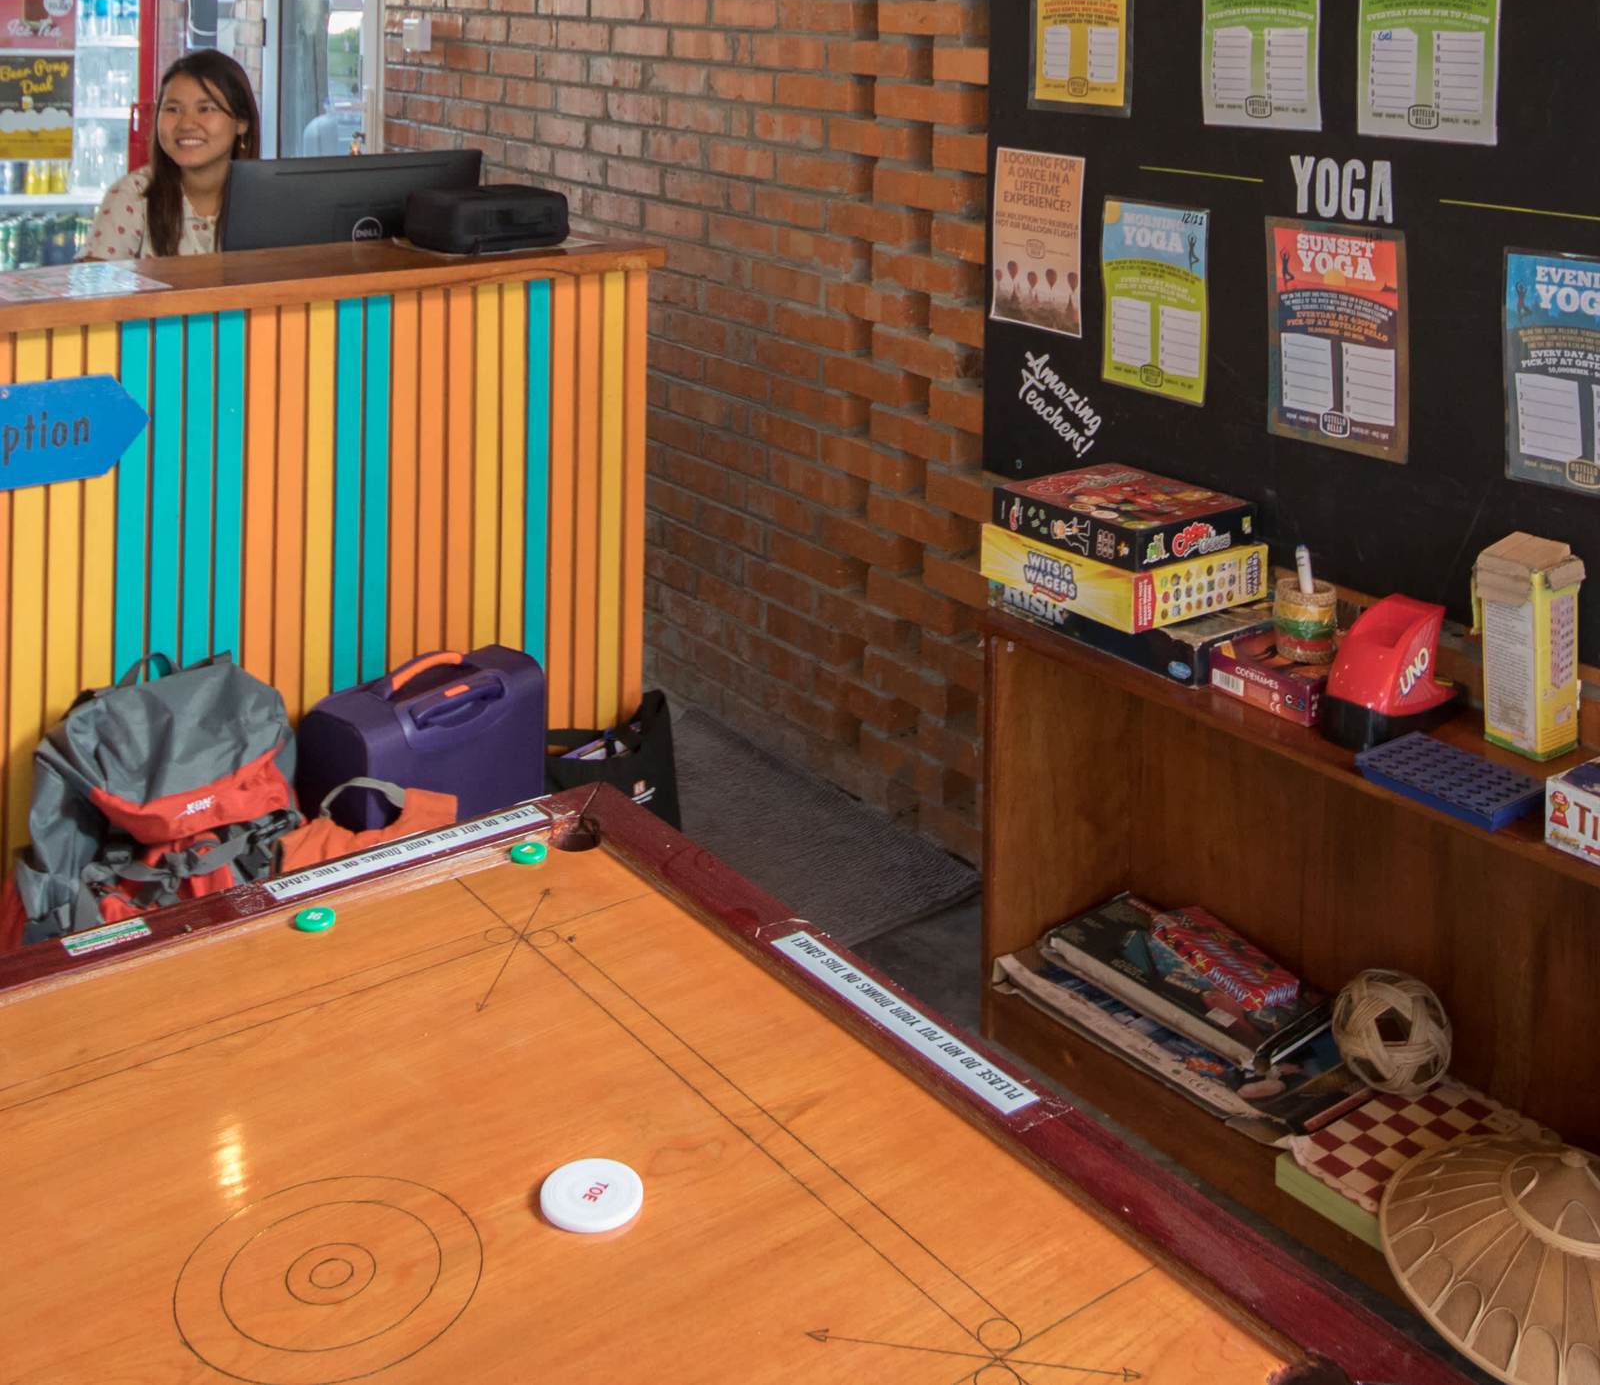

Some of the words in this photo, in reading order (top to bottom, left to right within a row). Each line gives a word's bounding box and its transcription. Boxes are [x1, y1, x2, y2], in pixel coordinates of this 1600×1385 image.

[1003, 151, 1051, 170] LOOKING
[1054, 158, 1076, 172] FOR
[1008, 166, 1015, 177] A
[1017, 167, 1046, 182] ONCE
[1048, 171, 1060, 183] IN
[1062, 174, 1071, 184] A
[1014, 178, 1061, 198] LIFETIME
[1290, 154, 1394, 224] YOGA
[1003, 190, 1072, 214] EXPERIENCE?
[1122, 225, 1184, 253] YOGA
[1297, 233, 1375, 258] SUNSET
[1297, 249, 1377, 282] YOGA
[1536, 283, 1600, 316] YOG
[1530, 349, 1561, 359] EVERY
[1564, 349, 1585, 360] DAY
[1560, 358, 1573, 366] AT
[1024, 351, 1102, 436] Amazing
[1018, 368, 1095, 459] Teachers!
[2, 410, 91, 467] ption
[1027, 551, 1059, 575] WITS
[1060, 562, 1073, 580] &
[1023, 564, 1078, 601] WAGERS
[1003, 586, 1066, 626] RISK
[1235, 666, 1279, 690] CODENAMES
[1400, 647, 1429, 695] UNO
[461, 823, 481, 835] NOT
[484, 818, 499, 829] DO
[405, 837, 434, 851] YOUR
[436, 829, 458, 841] PUT
[342, 858, 359, 869] ON
[363, 846, 403, 864] DRINKS
[314, 863, 341, 878] THIS
[269, 872, 311, 894] GAME!
[790, 936, 824, 960] GAME!
[821, 956, 843, 974] THIS
[842, 971, 858, 985] ON
[855, 981, 893, 1009] DRINKS
[890, 1005, 921, 1027] YOUR
[916, 1025, 943, 1043] PUT
[936, 1041, 966, 1061] NOT
[960, 1056, 982, 1071] DO
[975, 1067, 1025, 1102] PLEASE
[582, 1181, 609, 1203] TOE
